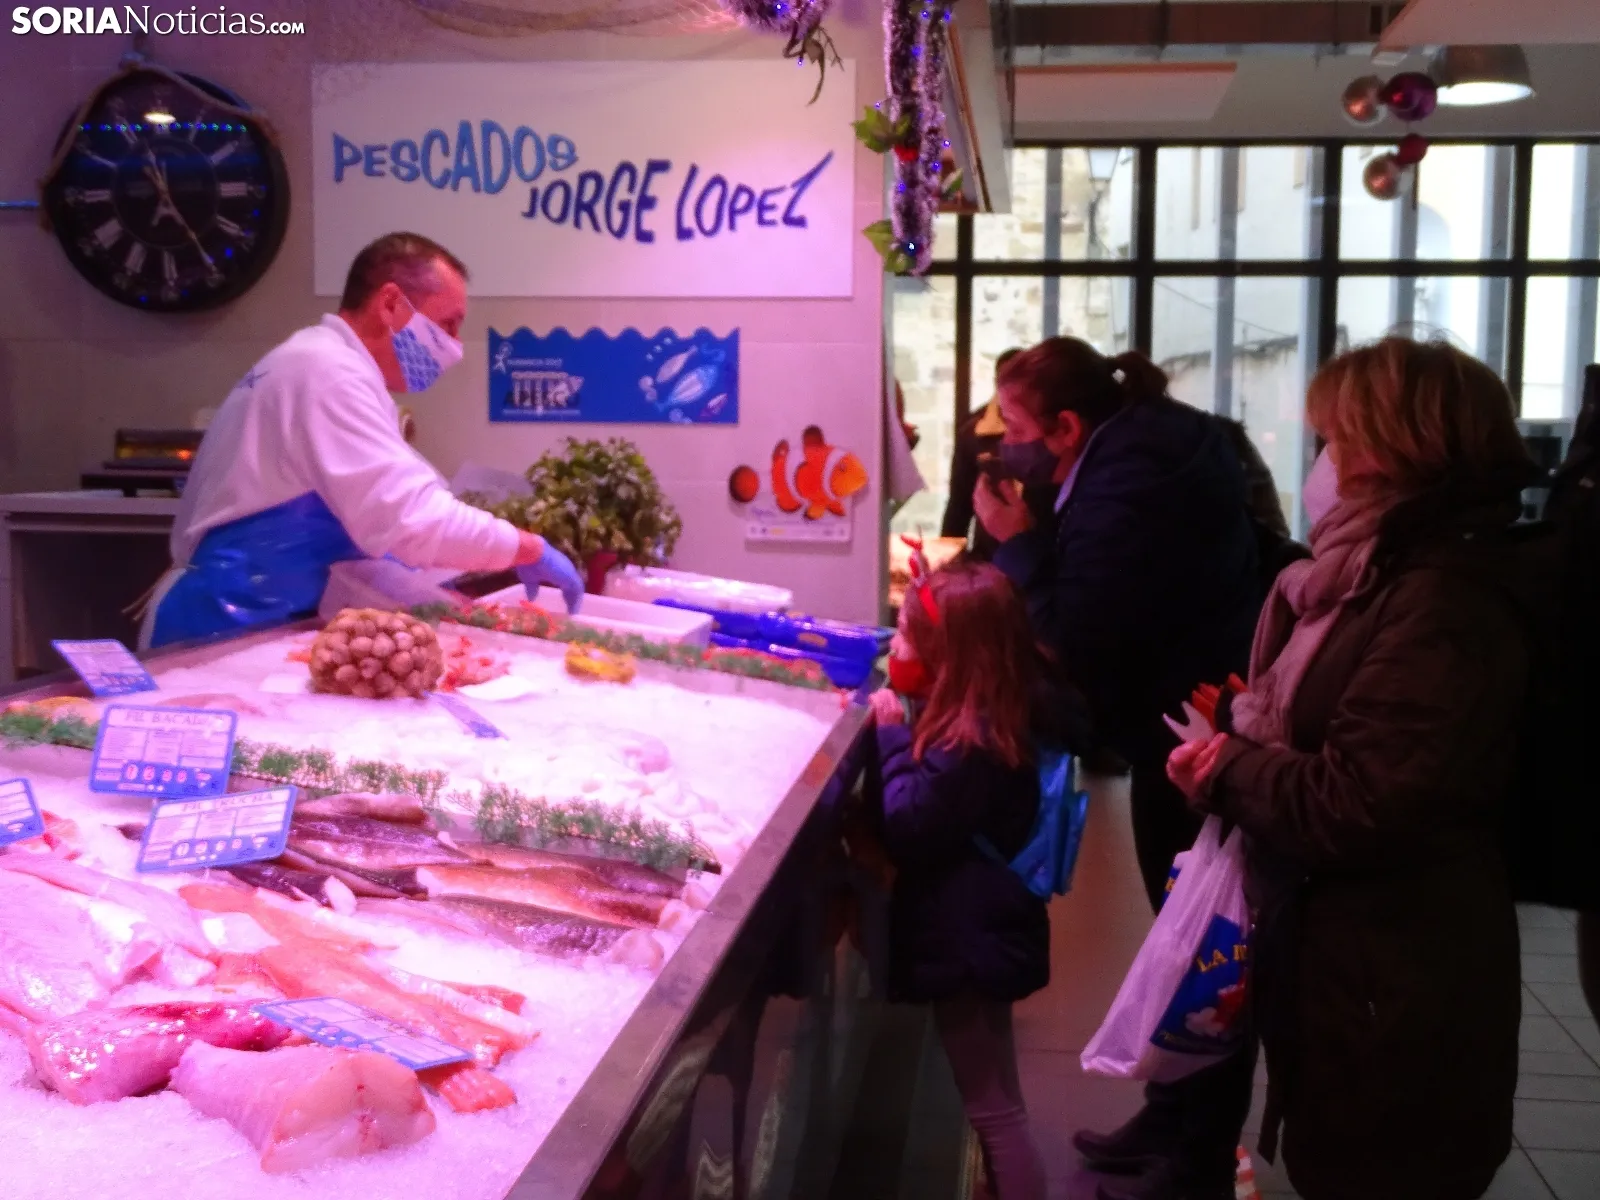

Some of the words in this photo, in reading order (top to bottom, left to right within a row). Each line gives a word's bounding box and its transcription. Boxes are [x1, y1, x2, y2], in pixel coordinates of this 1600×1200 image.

[332, 119, 579, 195] PESCADOS
[521, 159, 671, 244] JORGE
[675, 150, 834, 241] LOPEZ
[1197, 948, 1228, 973] LA
